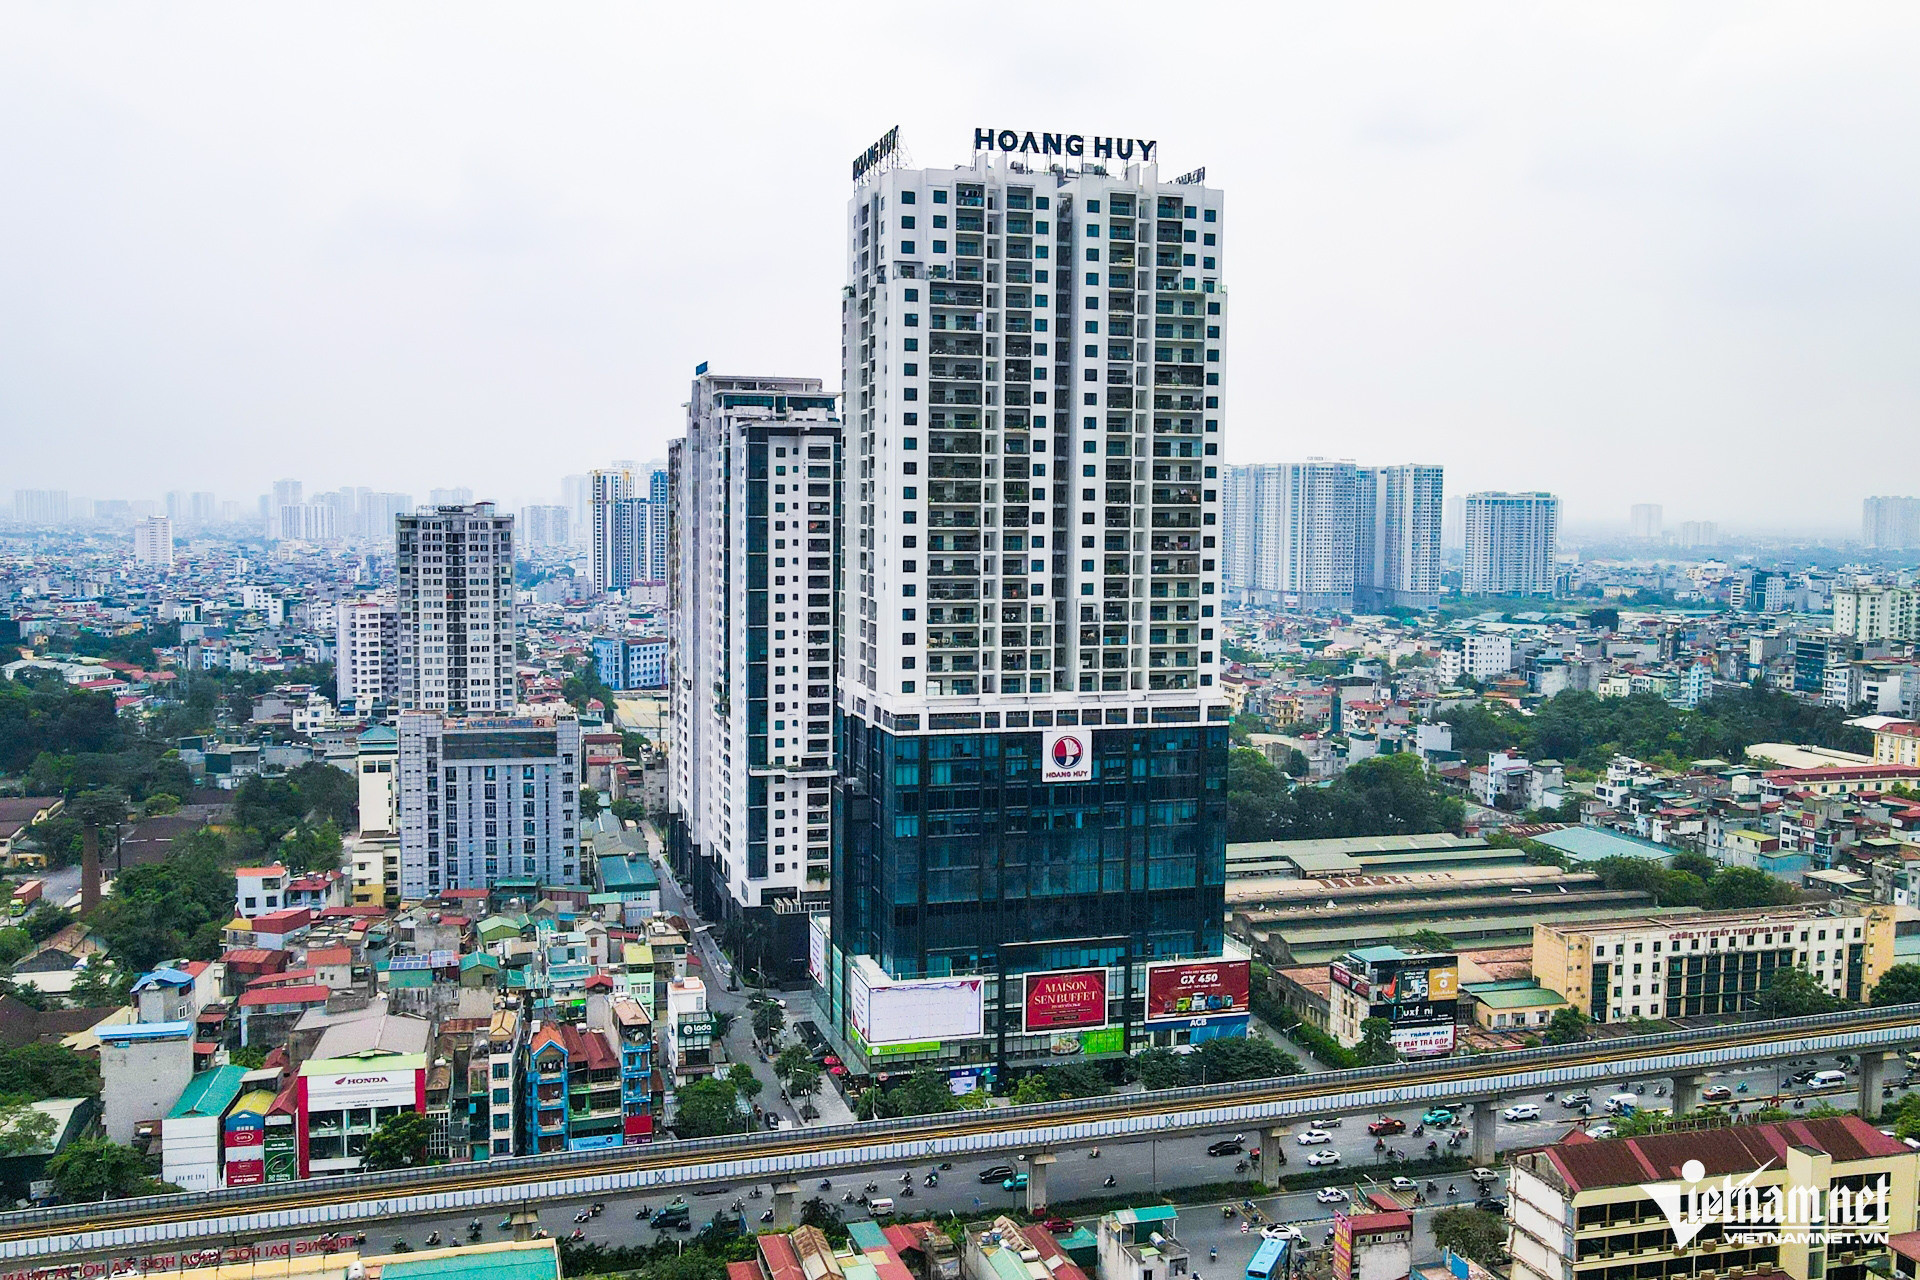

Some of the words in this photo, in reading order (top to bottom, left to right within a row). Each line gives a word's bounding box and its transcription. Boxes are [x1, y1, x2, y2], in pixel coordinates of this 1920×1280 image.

[975, 127, 1083, 157] HOANG
[1094, 136, 1157, 161] HUY
[1696, 930, 1708, 938] TY
[1180, 975, 1196, 985] GX
[1197, 973, 1218, 983] 450
[1045, 980, 1088, 993] MAISON
[1034, 994, 1056, 1005] SEN
[1056, 991, 1098, 1003] BUFFET
[1190, 1018, 1207, 1027] ACB
[347, 1076, 389, 1085] HONDA
